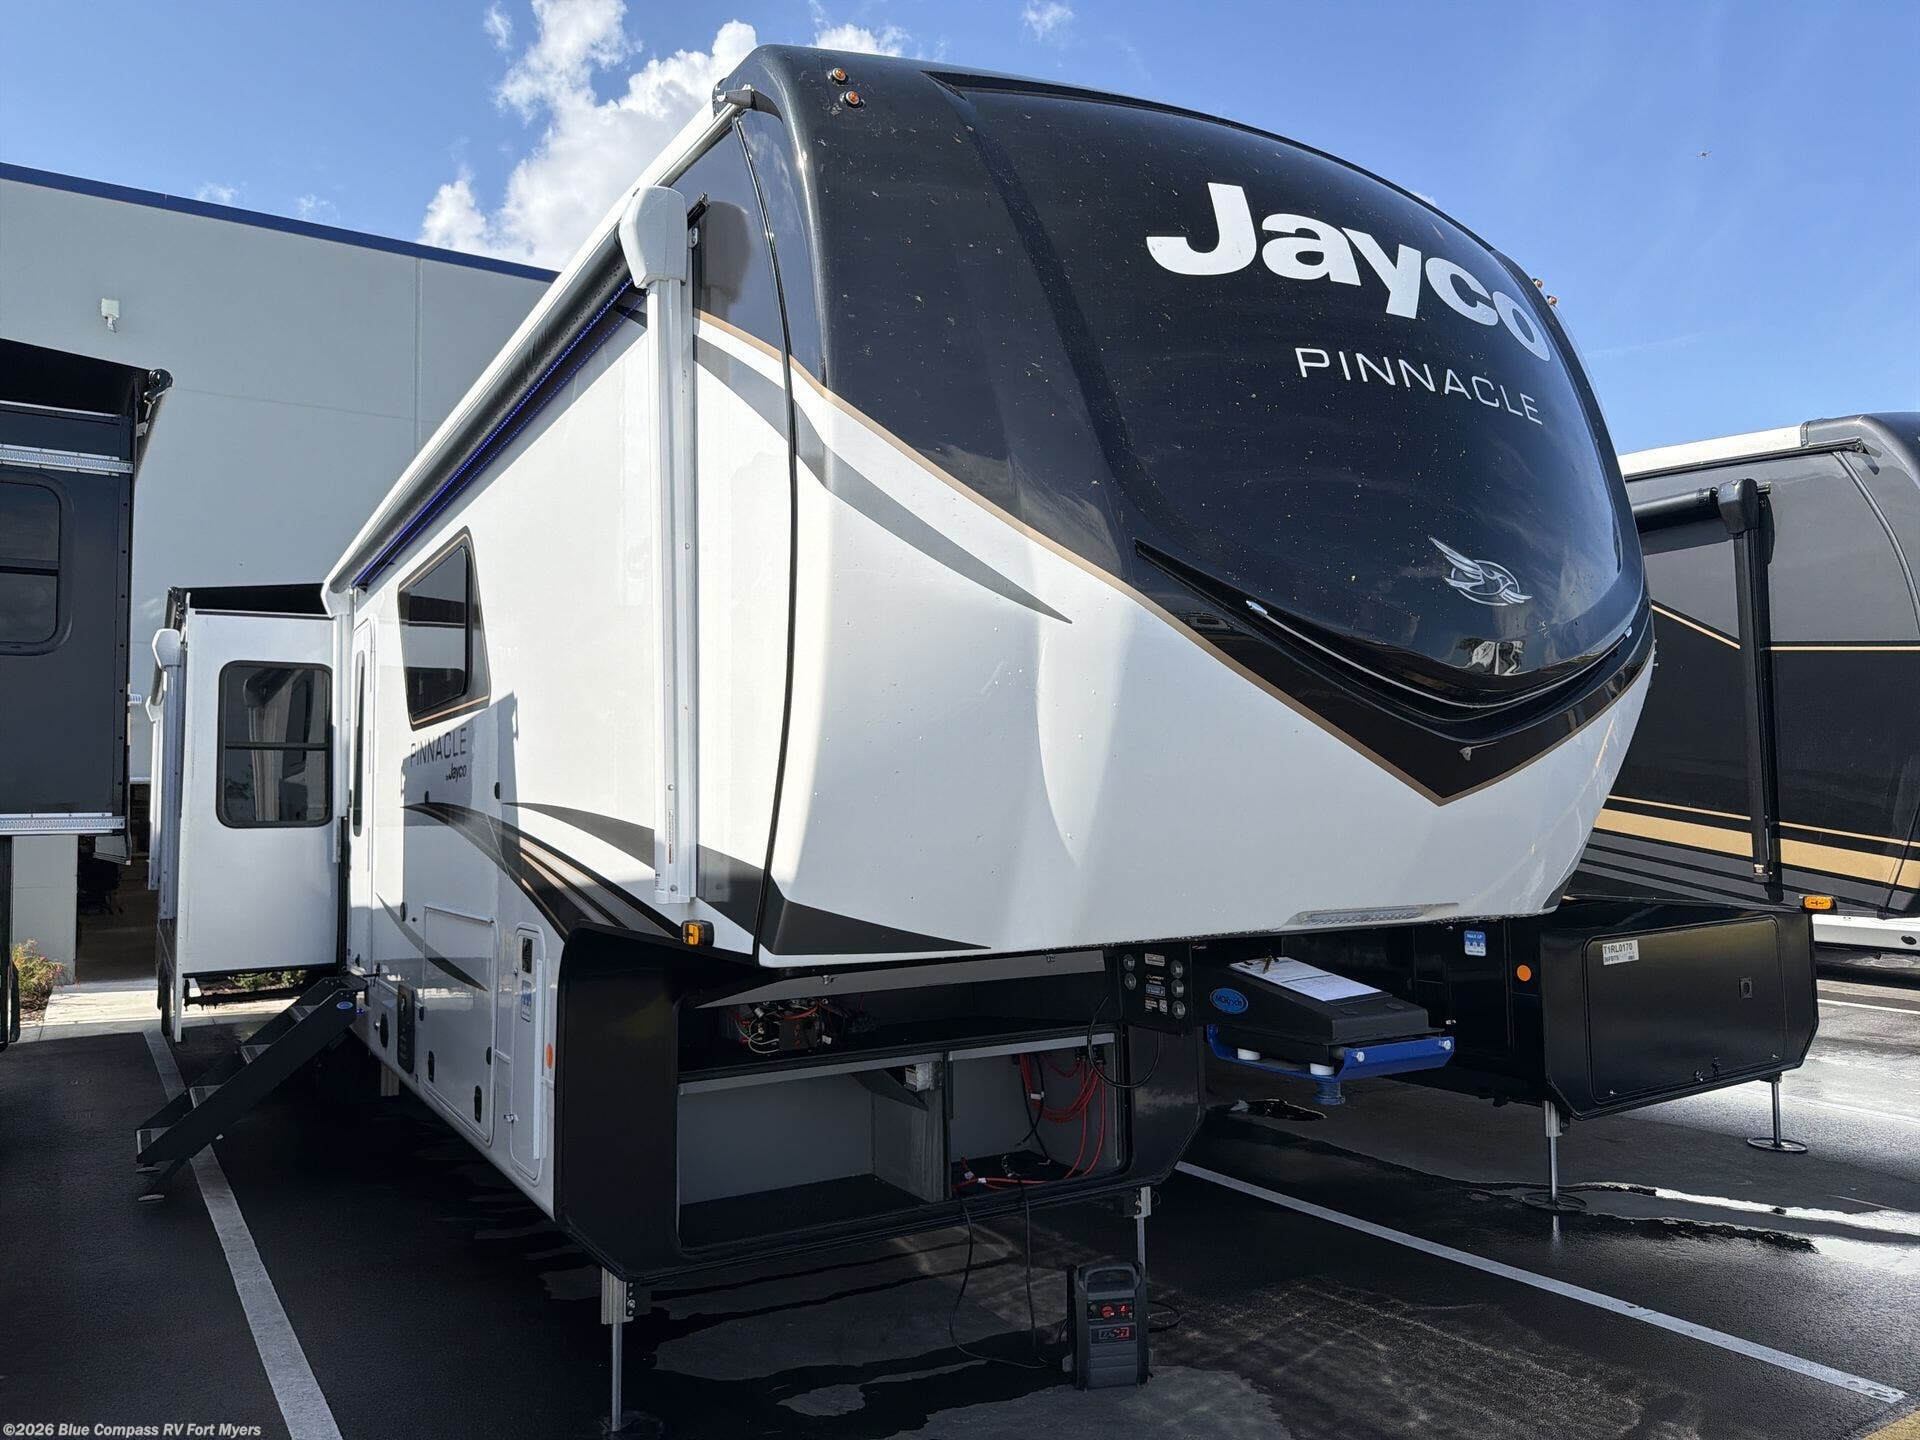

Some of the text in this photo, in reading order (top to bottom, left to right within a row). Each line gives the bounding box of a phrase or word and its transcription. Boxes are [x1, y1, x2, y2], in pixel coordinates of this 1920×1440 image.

[1146, 182, 1550, 362] Jayco
[1295, 347, 1543, 425] PINNACLE
[411, 728, 466, 767] PINNACLE
